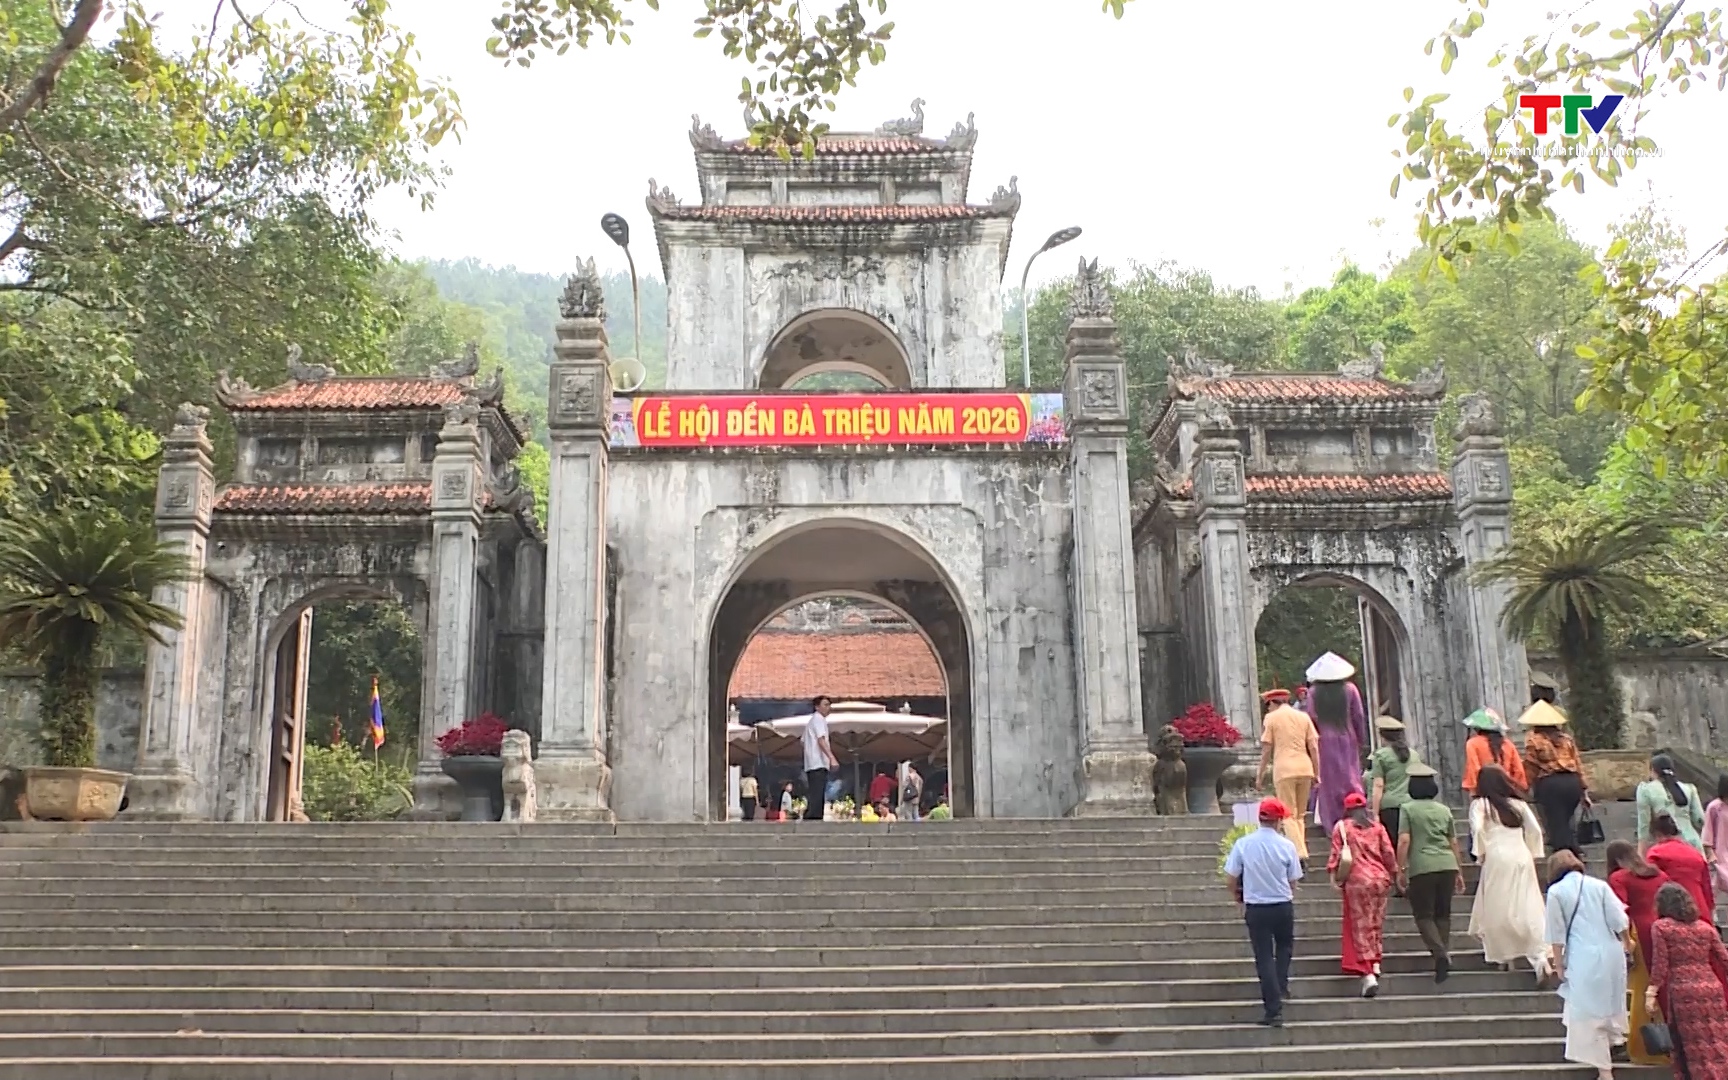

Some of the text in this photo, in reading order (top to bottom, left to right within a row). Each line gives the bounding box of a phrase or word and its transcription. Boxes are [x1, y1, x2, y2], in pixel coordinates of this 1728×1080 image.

[643, 400, 672, 438] LỄ
[678, 403, 720, 442] HỘI
[782, 403, 816, 436] BÀ
[821, 402, 891, 441] TRIỆU
[897, 402, 955, 435] NĂM
[961, 406, 1021, 434] 2026
